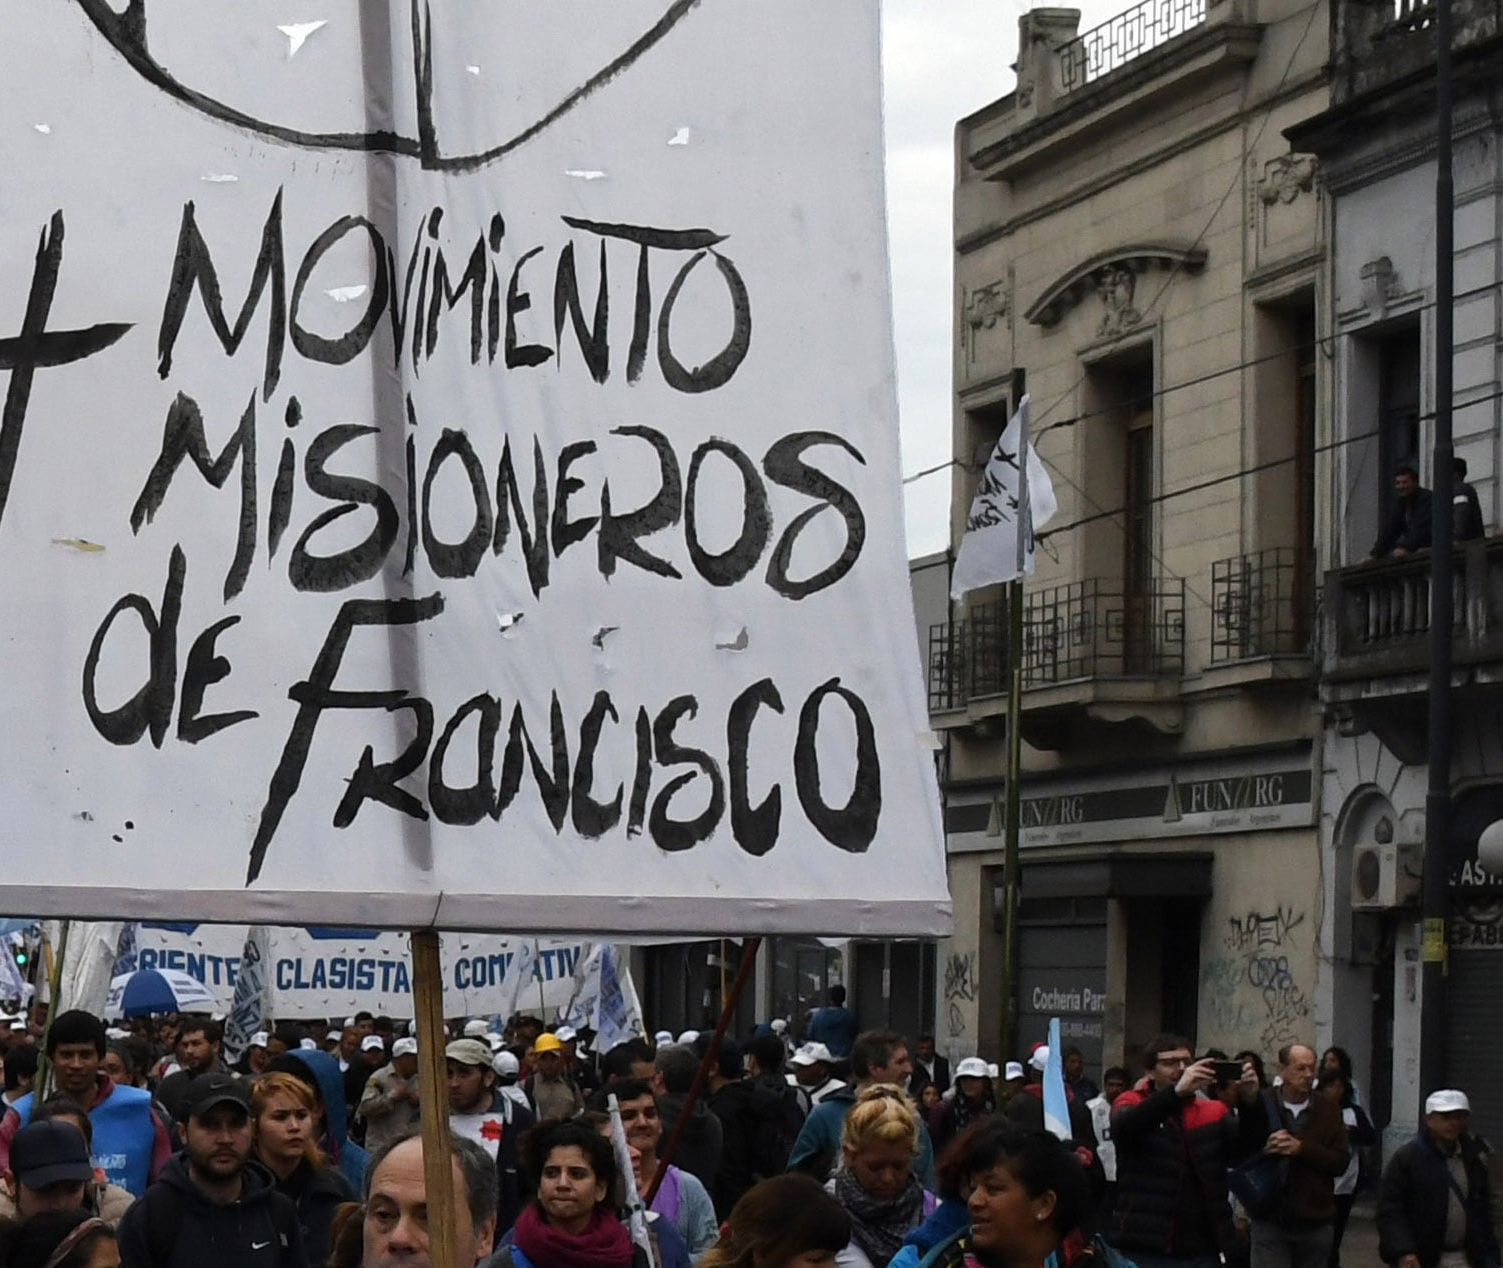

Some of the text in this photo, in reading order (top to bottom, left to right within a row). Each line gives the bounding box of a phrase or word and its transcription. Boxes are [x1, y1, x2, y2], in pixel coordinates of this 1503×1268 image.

[157, 184, 754, 403] MOVIMIENTO
[130, 388, 869, 603] MISIONEROS
[275, 957, 411, 994] CLASISTA
